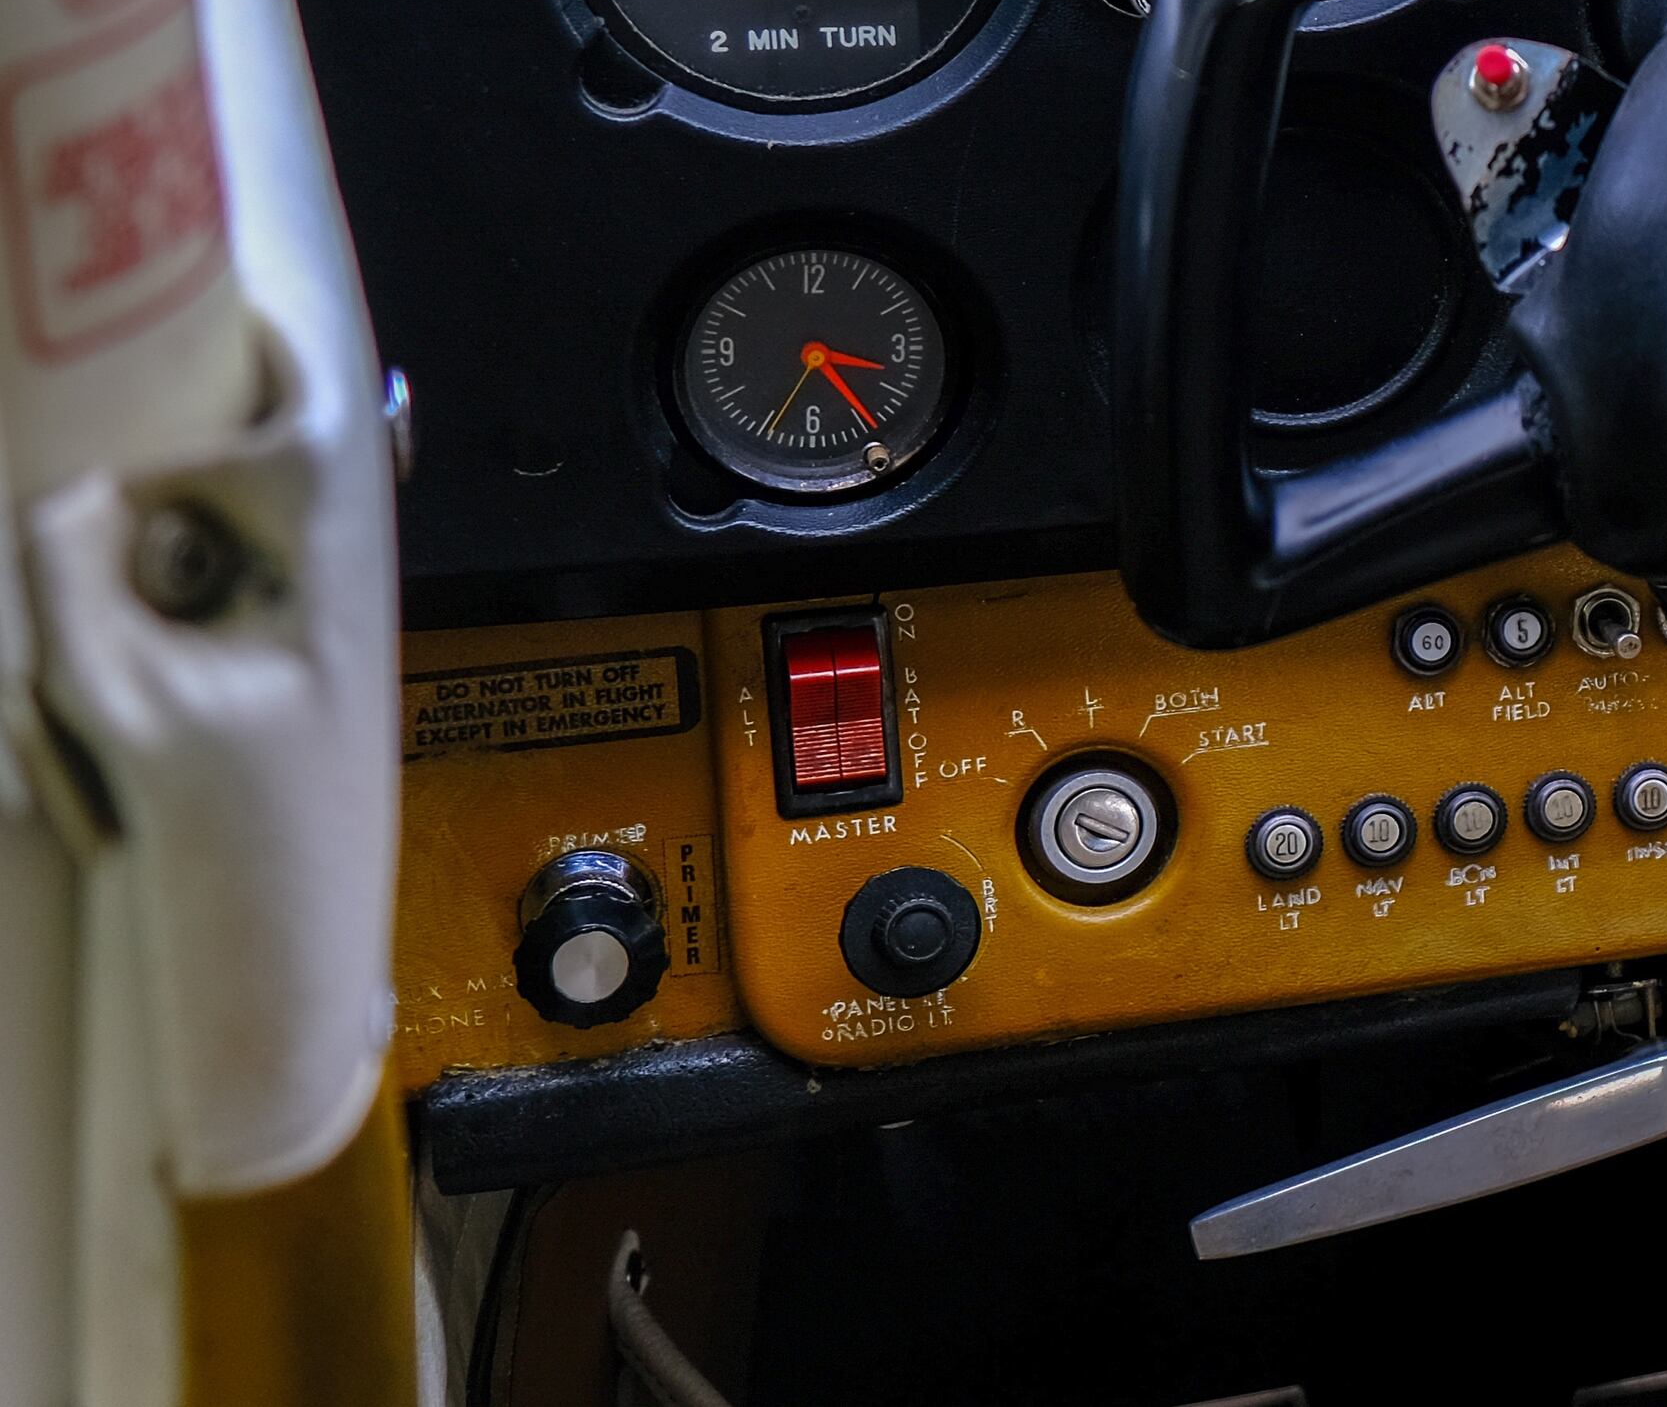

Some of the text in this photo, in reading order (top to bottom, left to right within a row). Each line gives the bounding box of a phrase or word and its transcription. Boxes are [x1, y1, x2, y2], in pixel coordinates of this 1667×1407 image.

[710, 25, 896, 53] 2 MIN TURN
[804, 264, 825, 294] 12
[719, 337, 734, 367] 9
[891, 333, 906, 363] 3
[806, 405, 821, 434] 6
[895, 605, 916, 641] ON
[1516, 620, 1530, 644] 5
[1421, 635, 1445, 652] 60
[436, 664, 640, 701] DO NOT TURN OFF
[1498, 681, 1536, 702] ALT
[417, 683, 664, 724] ALTERNATOR IN FLIGHT
[1154, 687, 1221, 711] BOTH
[1408, 692, 1446, 714] ALT
[1491, 701, 1552, 723] FIELD
[415, 704, 665, 746] EXCEPT IN EMERGENCY
[1197, 723, 1268, 748] START
[938, 756, 988, 778] OFF
[789, 816, 899, 847] MASTER
[1274, 831, 1300, 858] 20
[1257, 886, 1321, 912] LAND
[1356, 876, 1404, 898] NAV
[1464, 886, 1491, 907] LT
[680, 844, 701, 965] PRIMER
